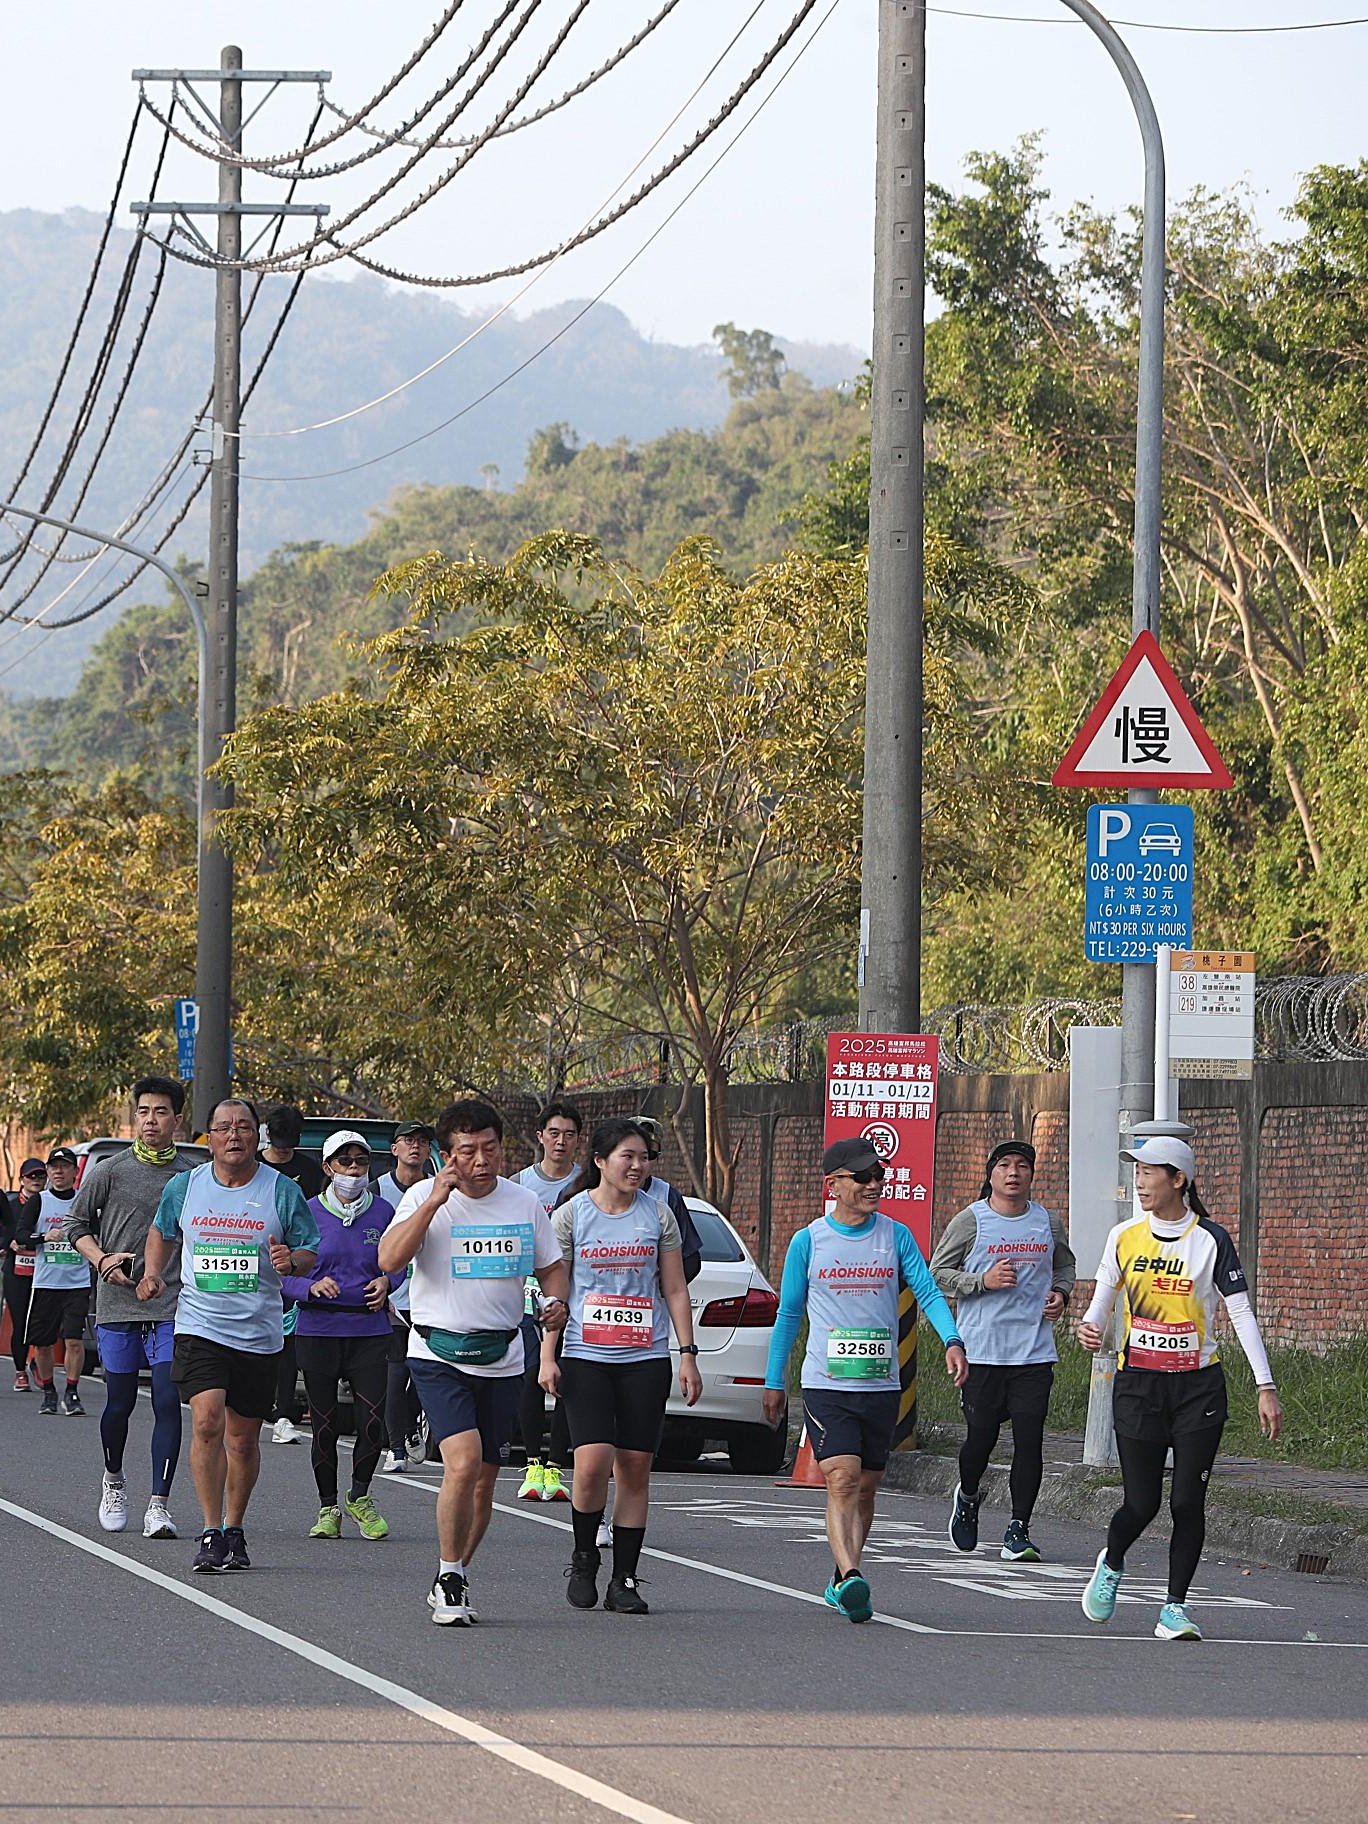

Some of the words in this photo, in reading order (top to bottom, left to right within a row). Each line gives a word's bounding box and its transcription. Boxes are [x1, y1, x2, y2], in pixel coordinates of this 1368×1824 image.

[1114, 706, 1172, 764] 慢
[1098, 809, 1132, 857] P
[1090, 862, 1188, 882] 08:00-20:00
[1123, 922, 1138, 936] PER
[1141, 922, 1154, 936] SIX
[1158, 922, 1187, 937] HOURS
[1202, 955, 1242, 967] 桃子園
[1181, 975, 1195, 990] 38
[1180, 997, 1195, 1012] 219
[840, 1038, 886, 1053] 2025
[832, 1061, 932, 1080] 本路段停車格
[832, 1082, 875, 1097] 01/11
[887, 1083, 931, 1098] 01/12
[831, 1101, 931, 1120] 活動借用期間
[191, 1216, 265, 1231] KAOHSIUNG
[462, 1240, 514, 1254] 10116
[580, 1246, 655, 1258] KAOHSIUNG
[987, 1243, 1049, 1254] KAOHSIUNG
[201, 1258, 249, 1271] 31519
[1132, 1255, 1184, 1276] 台中山
[818, 1267, 894, 1279] KAOHSIUNG
[592, 1308, 643, 1324] 41639
[1137, 1333, 1189, 1349] 41205
[836, 1342, 886, 1356] 32586
